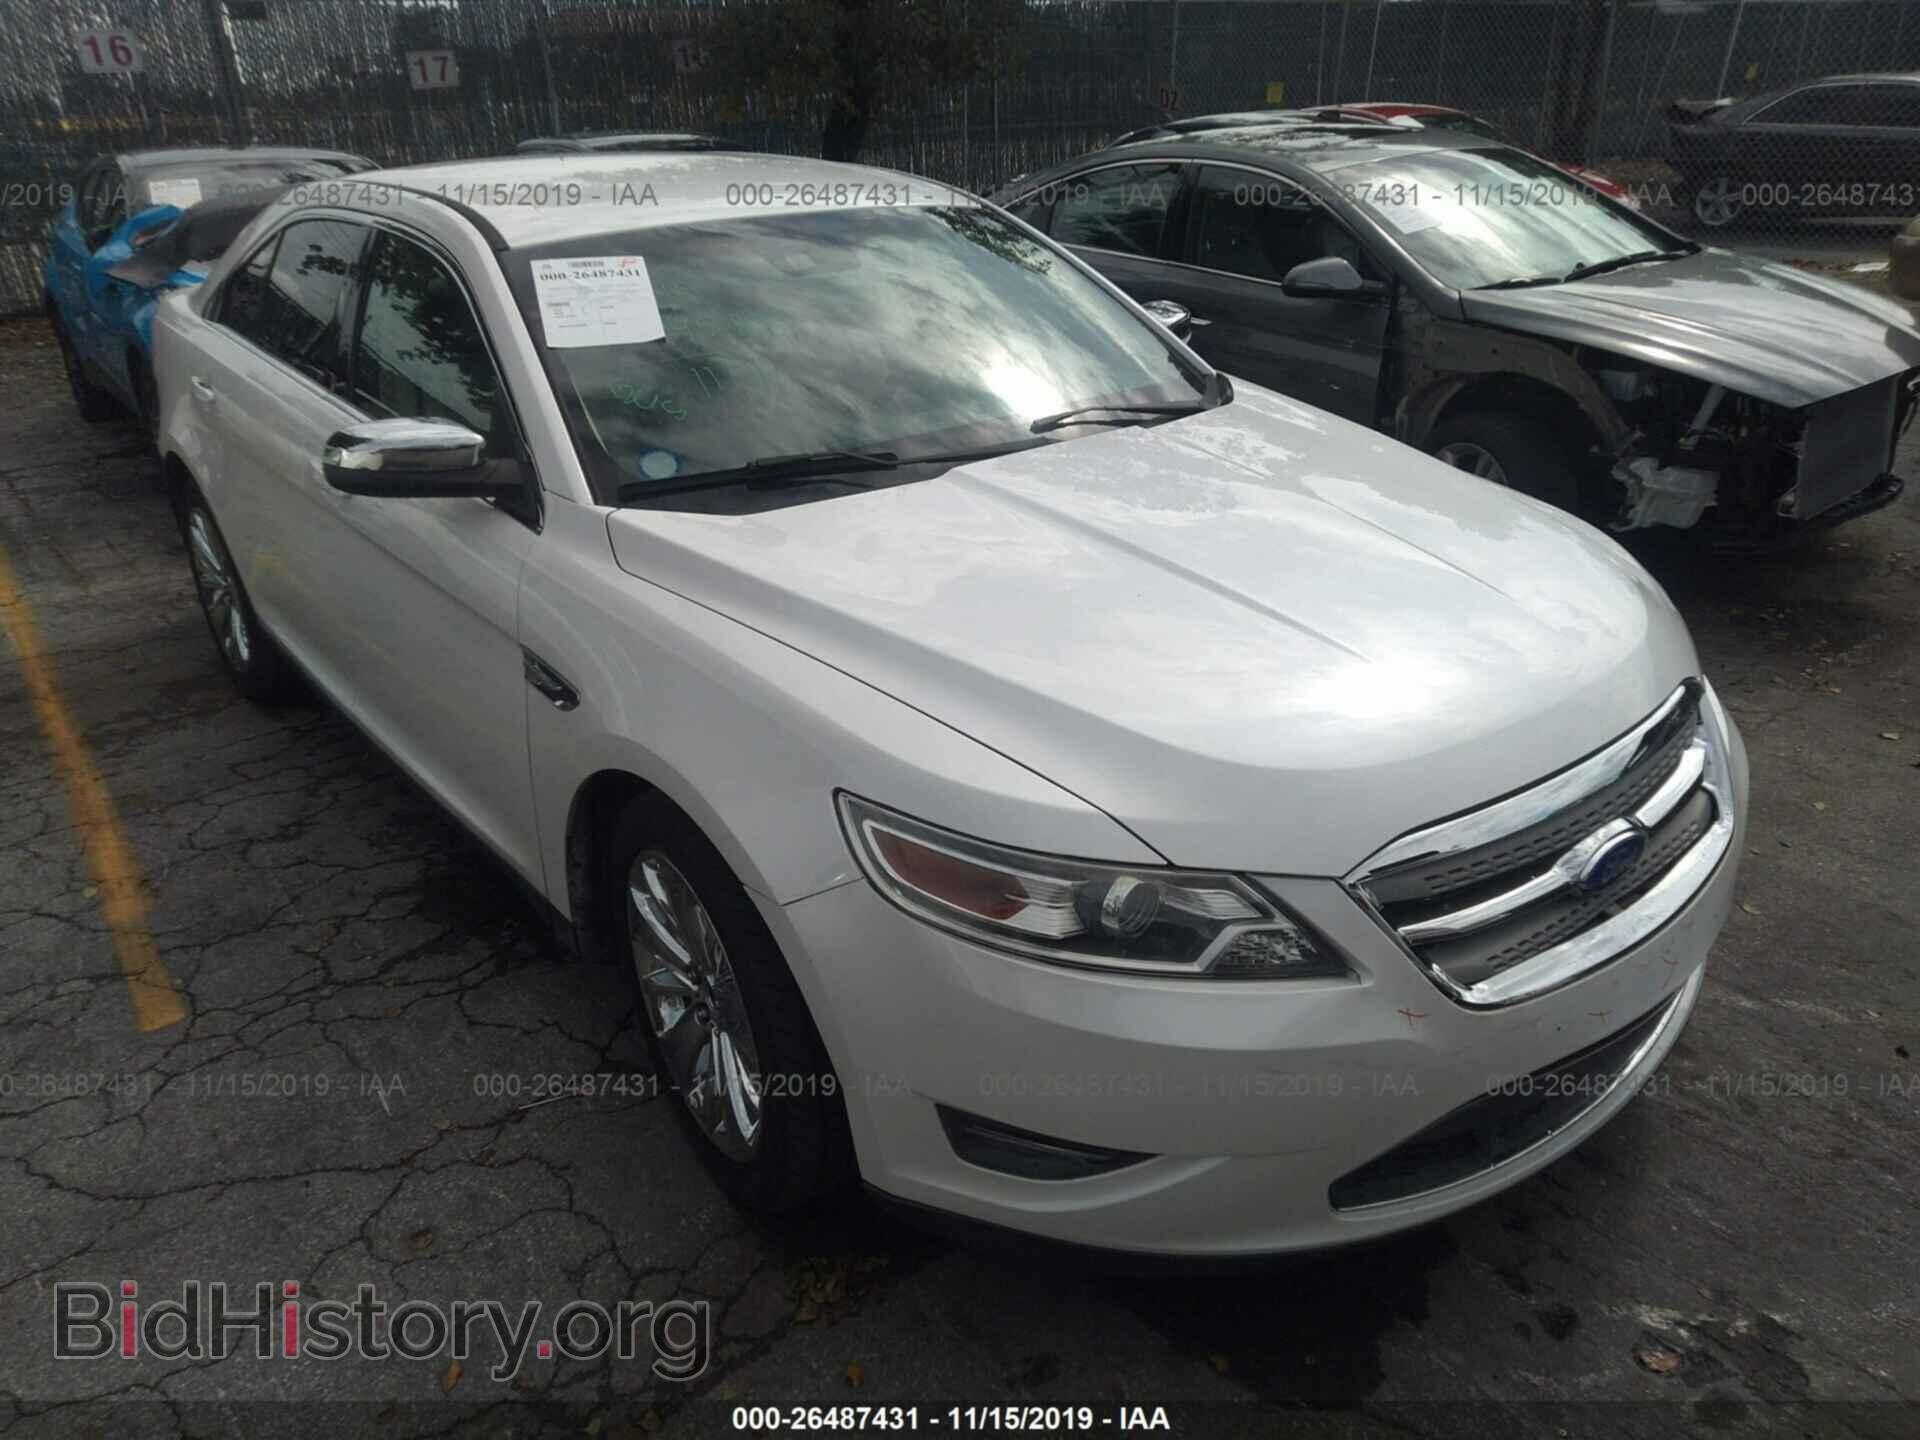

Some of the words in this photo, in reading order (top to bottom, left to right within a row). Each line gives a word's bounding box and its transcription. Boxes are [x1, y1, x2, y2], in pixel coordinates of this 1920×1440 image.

[81, 34, 134, 66] 16
[413, 55, 449, 83] 17
[539, 269, 641, 282] 000-26487431
